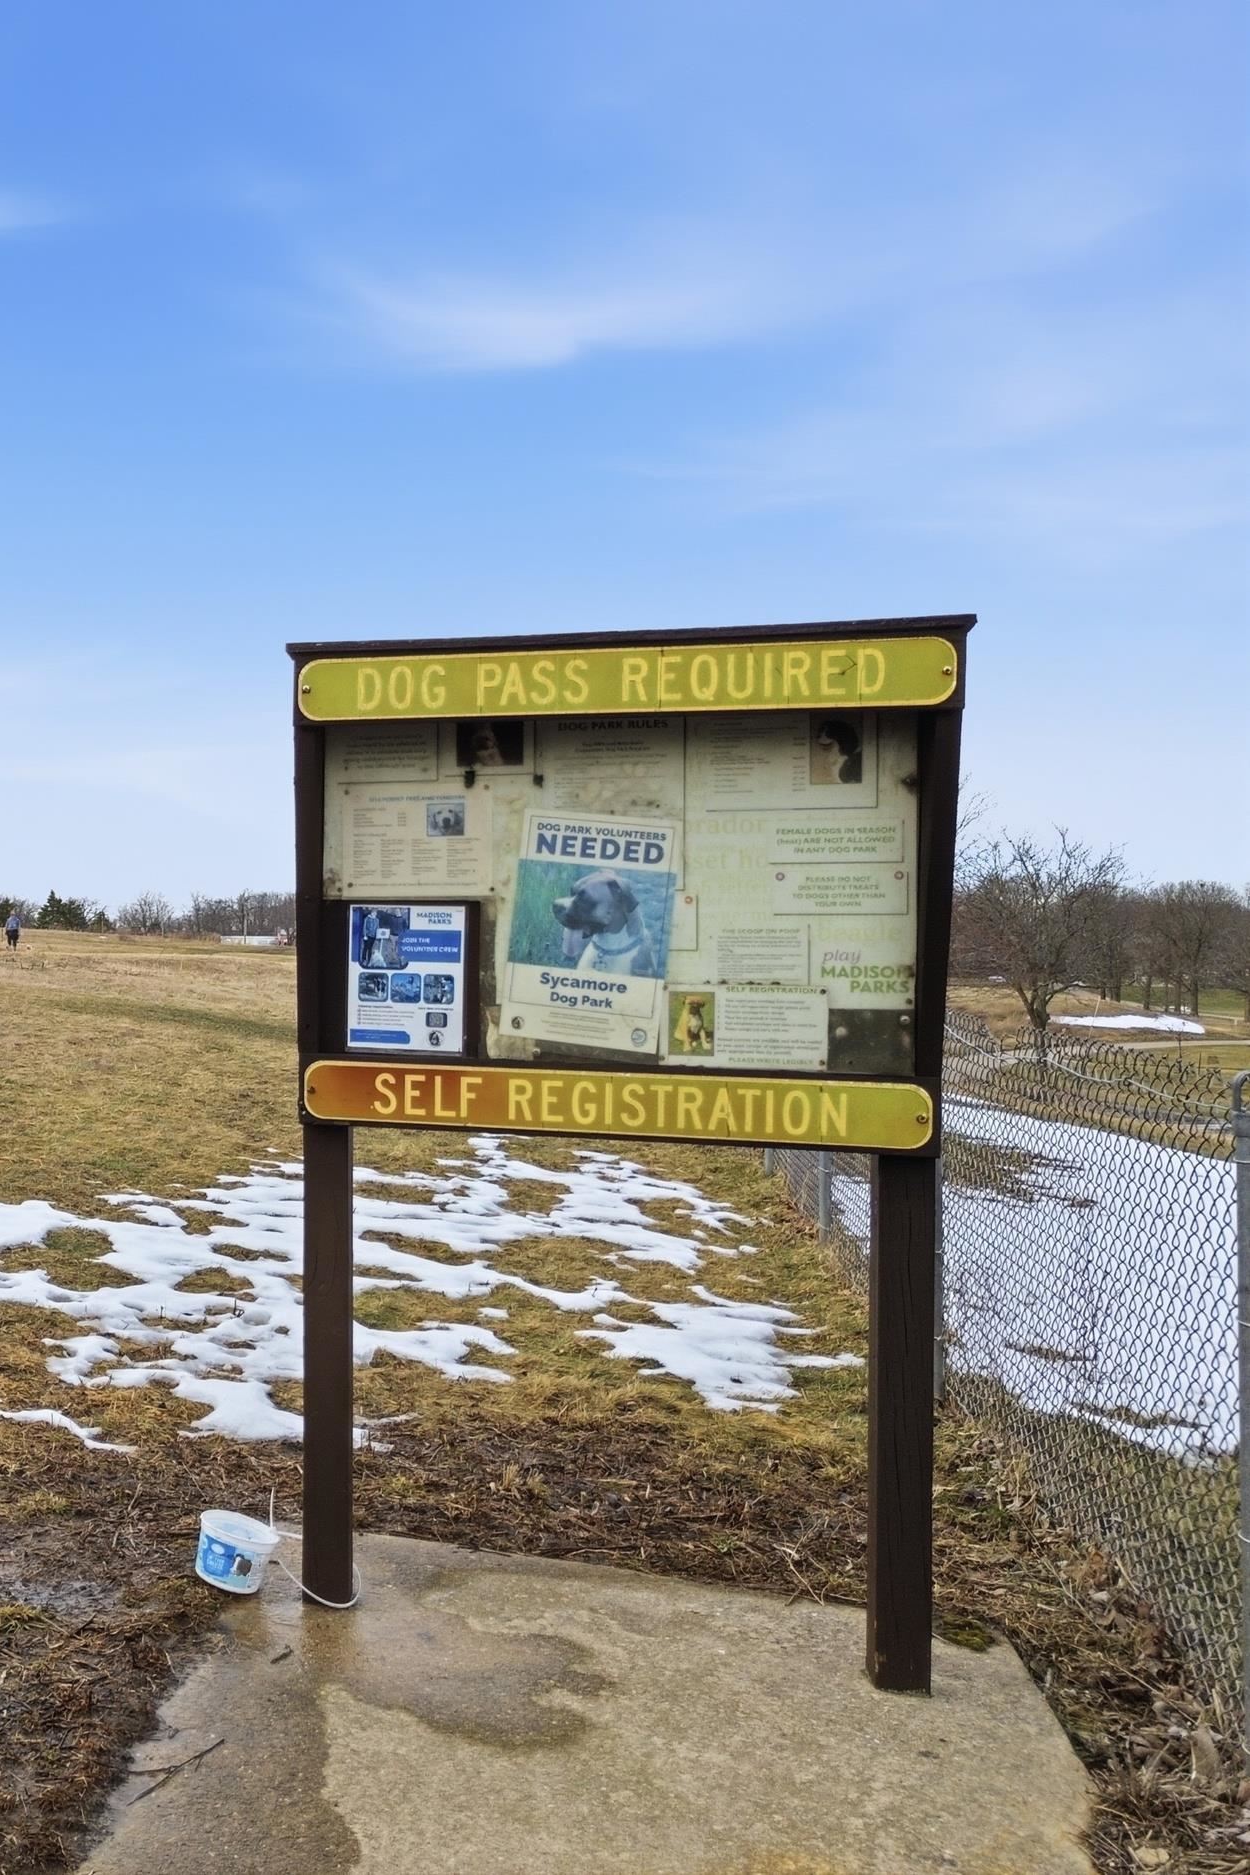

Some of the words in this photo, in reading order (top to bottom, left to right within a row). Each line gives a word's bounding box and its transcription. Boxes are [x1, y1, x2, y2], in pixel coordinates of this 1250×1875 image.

[357, 665, 446, 710] DOG
[476, 659, 590, 706] PASS
[621, 648, 885, 702] REQUIRED
[558, 722, 587, 732] DOG
[591, 720, 623, 730] PARK
[628, 719, 669, 729] RULES
[537, 822, 561, 832] DOG
[564, 825, 592, 835] PARK
[595, 828, 667, 841] VOLUNTEERS
[776, 827, 812, 835] FEMALE
[857, 826, 896, 834] SEASON
[535, 833, 665, 864] NEEDED
[416, 911, 452, 919] MADISON
[822, 949, 862, 964] play
[540, 972, 627, 994] Sycamore
[850, 980, 910, 993] PARKS
[550, 991, 578, 1007] Dog
[581, 994, 613, 1009] Park
[373, 1072, 483, 1118] SELF
[508, 1078, 847, 1137] REGISTRATION
